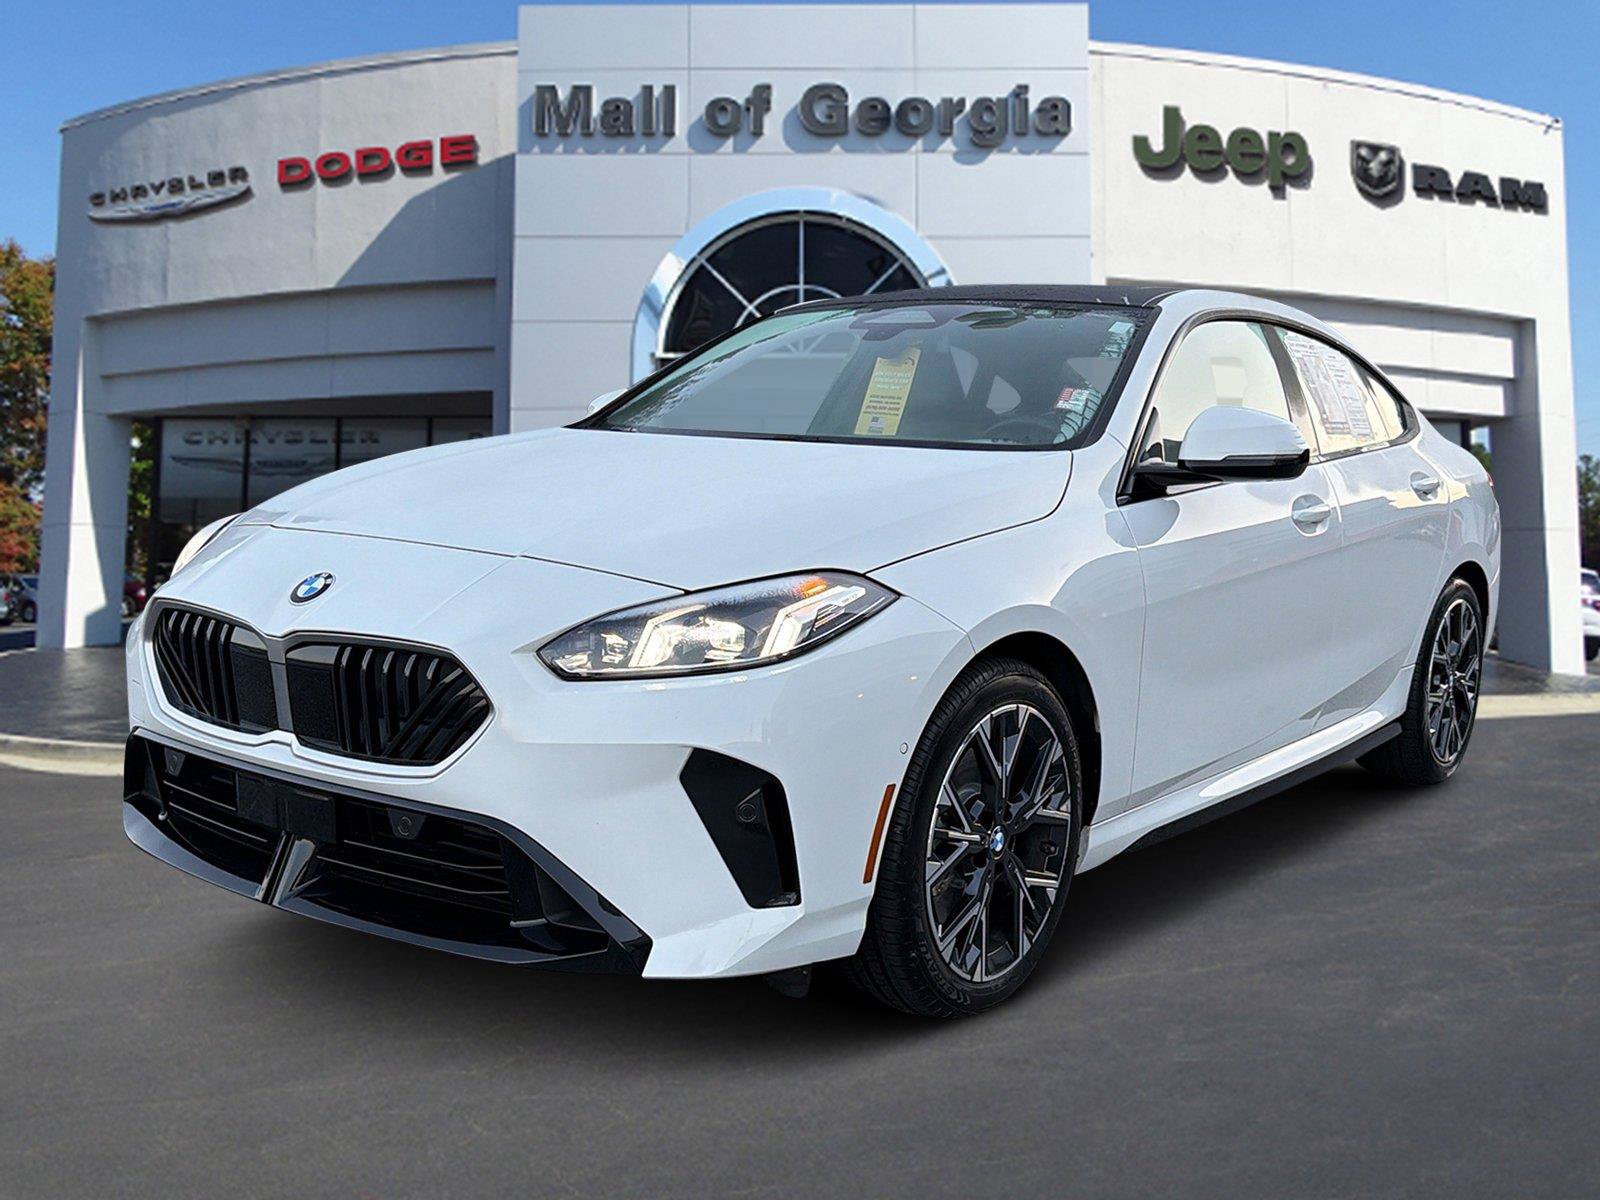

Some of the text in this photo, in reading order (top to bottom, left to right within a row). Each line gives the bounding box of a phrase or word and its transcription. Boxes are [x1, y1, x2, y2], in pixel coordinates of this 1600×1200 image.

[533, 83, 1073, 148] Mall of Georgia
[277, 135, 478, 190] DODGE
[1132, 105, 1312, 194] Jeep
[89, 166, 249, 207] CHRYSLER
[1411, 163, 1548, 214] RAM
